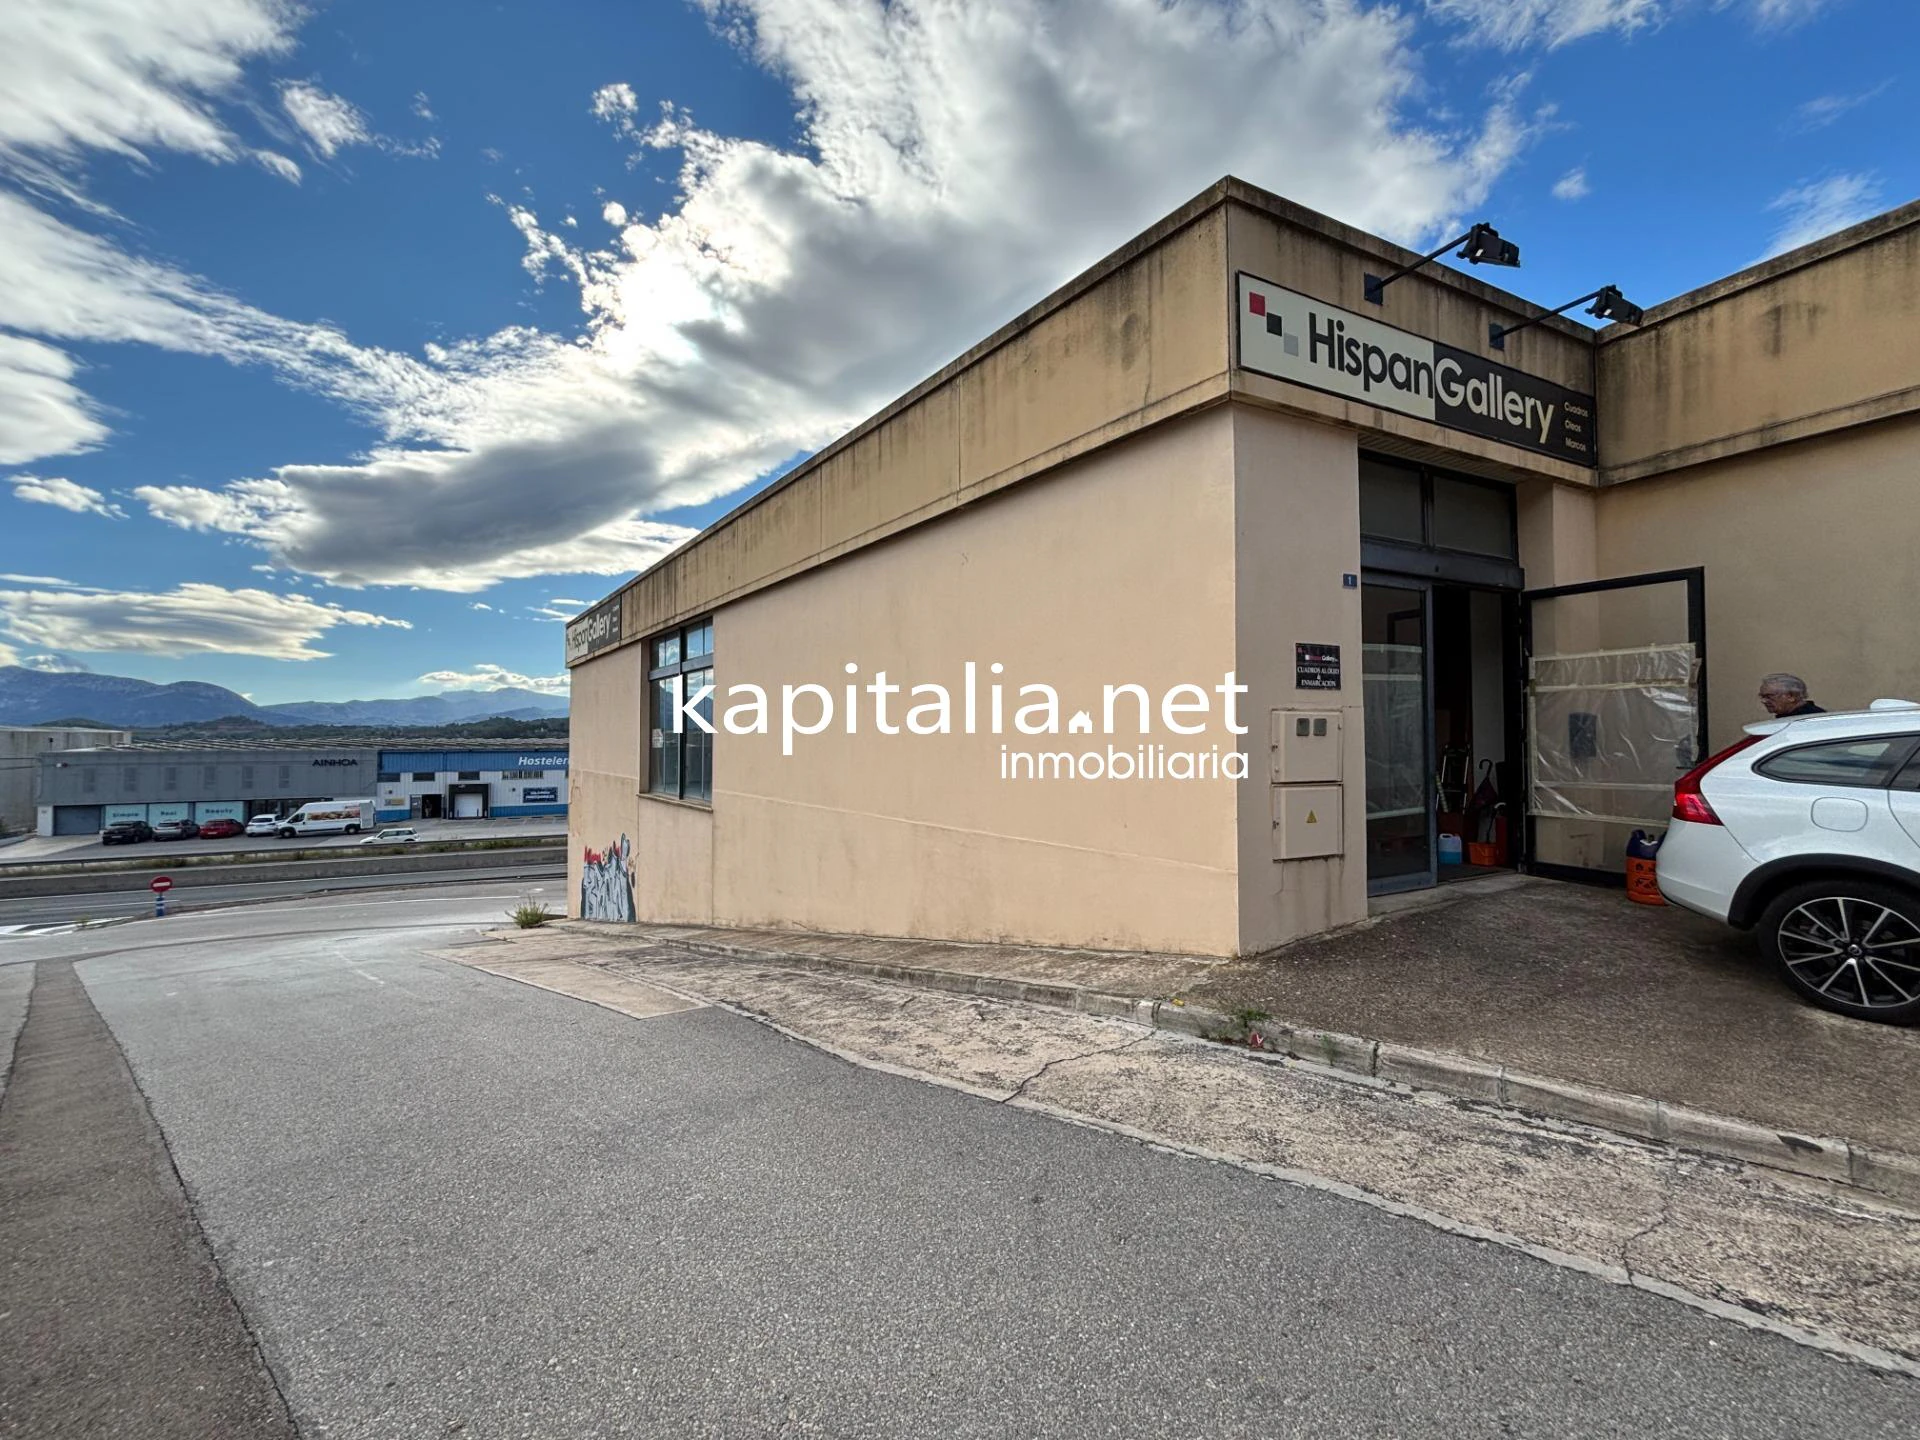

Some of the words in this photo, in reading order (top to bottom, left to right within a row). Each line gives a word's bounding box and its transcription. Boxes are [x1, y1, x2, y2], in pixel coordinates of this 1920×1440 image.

[1564, 401, 1588, 417] Cuadros
[1565, 436, 1586, 452] Marcos
[312, 759, 358, 767] AINHOA
